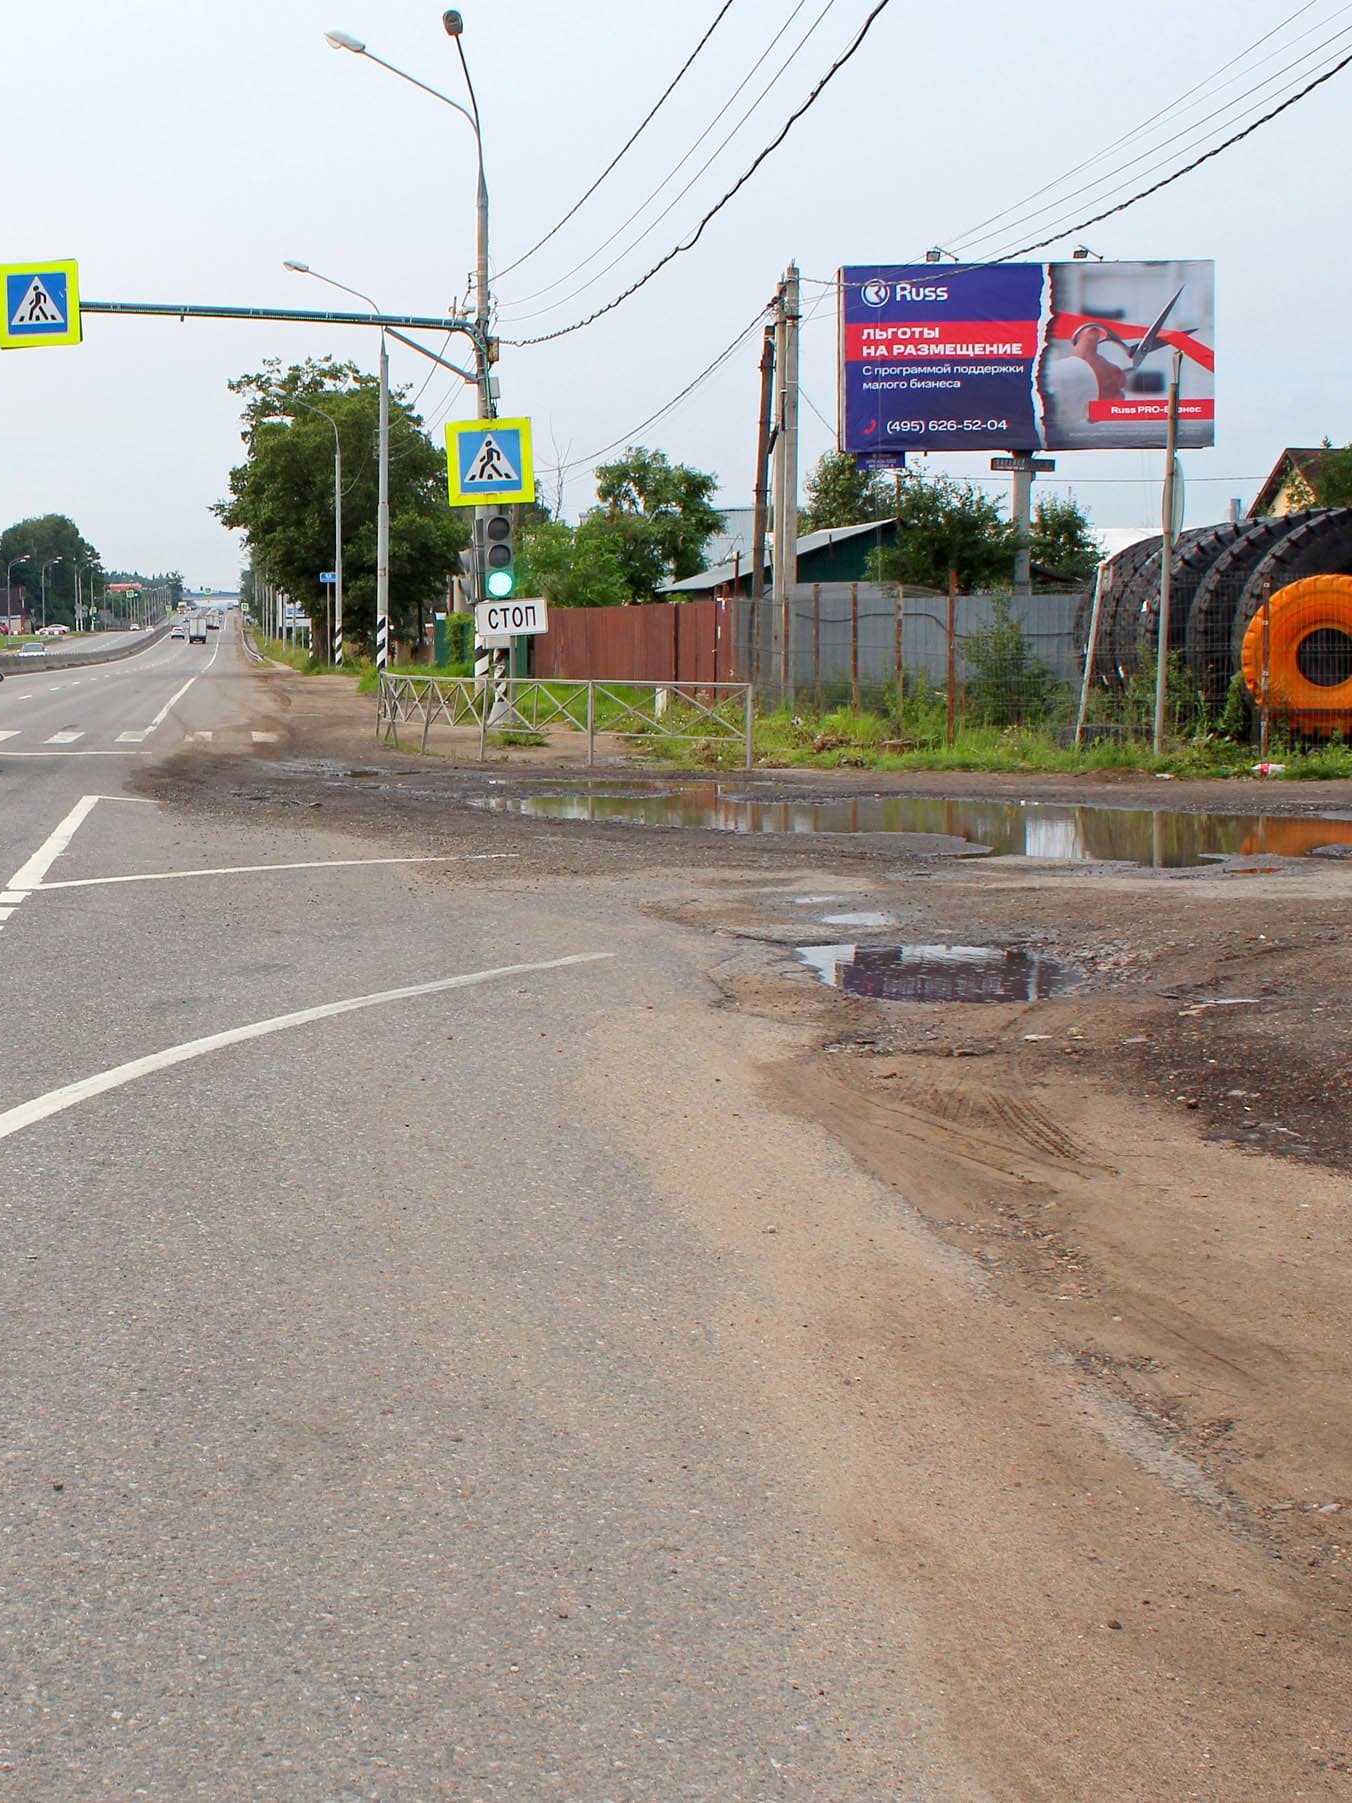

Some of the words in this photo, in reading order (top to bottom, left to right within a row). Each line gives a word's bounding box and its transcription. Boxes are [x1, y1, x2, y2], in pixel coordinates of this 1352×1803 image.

[895, 283, 948, 301] Russ
[861, 327, 940, 340] ЛЬГОТЫ
[862, 345, 888, 357] НА
[892, 343, 1023, 357] РАЗМЕЩЕНИЕ
[862, 366, 872, 376] С
[874, 364, 951, 377] программой
[953, 364, 1024, 376] поддержки
[862, 381, 908, 390] малого
[909, 378, 961, 389] бизнеса
[886, 420, 926, 434] (495)
[928, 419, 1008, 431] 626-52-04
[488, 605, 537, 630] СТОП
